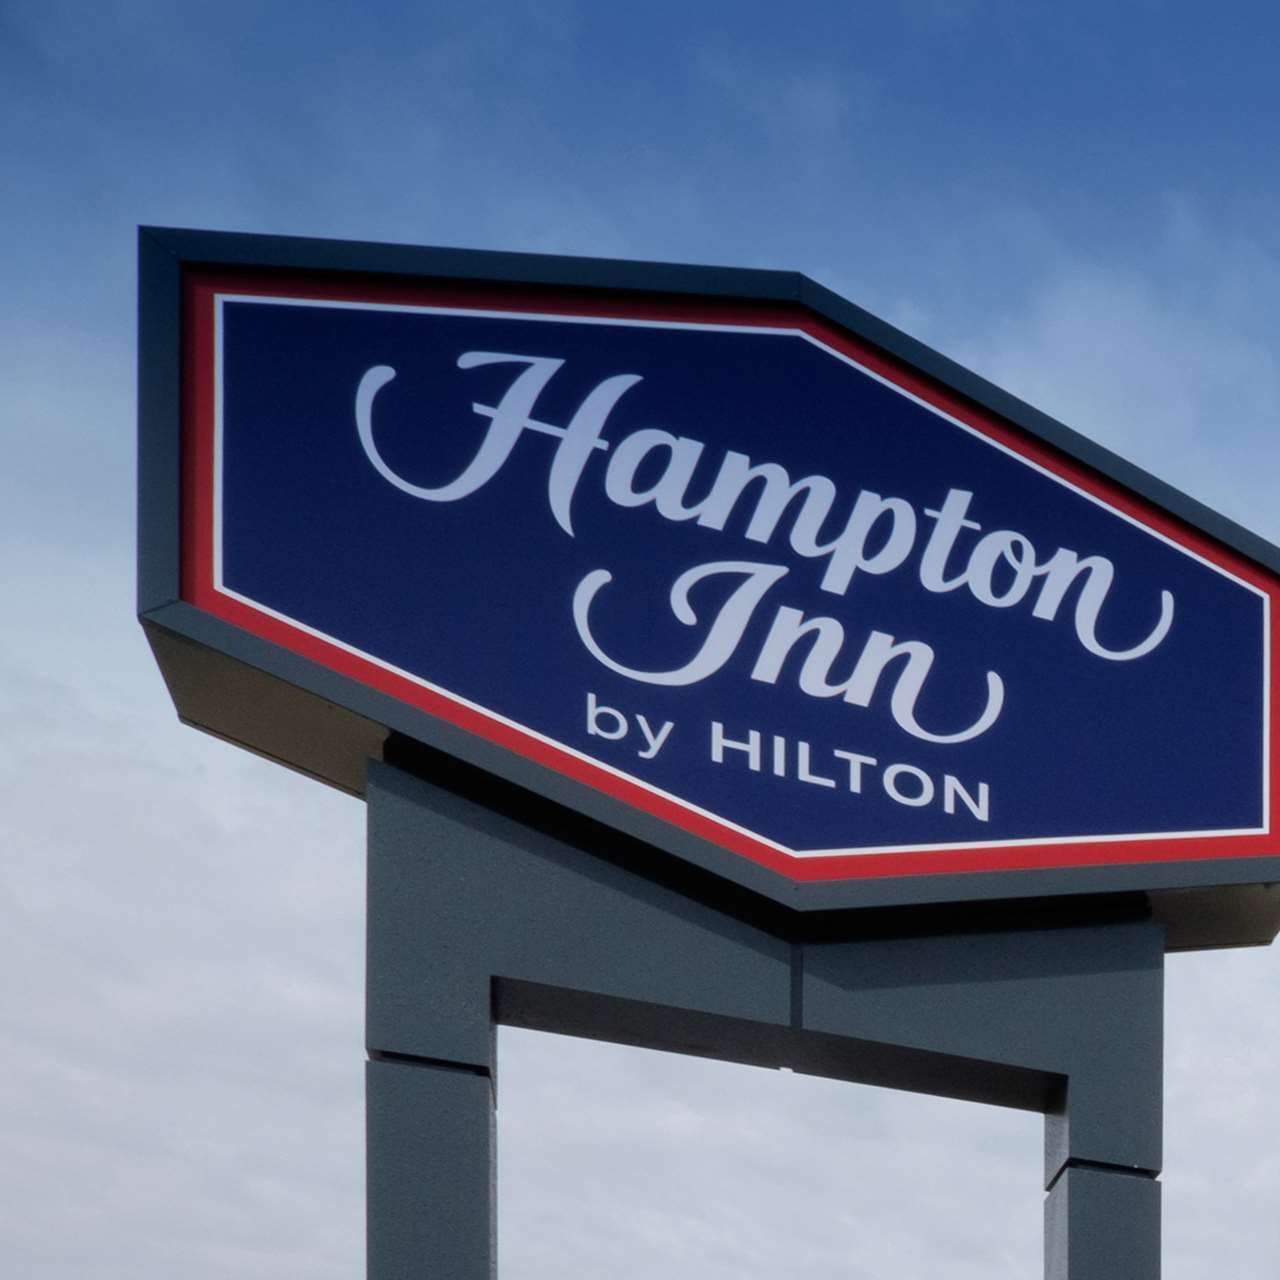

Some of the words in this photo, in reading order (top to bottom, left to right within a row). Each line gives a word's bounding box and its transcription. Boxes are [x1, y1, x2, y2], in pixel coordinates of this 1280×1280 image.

[354, 349, 1175, 662] Hampton
[572, 560, 1005, 744] Inn
[587, 692, 675, 759] by
[711, 721, 991, 822] HILTON
